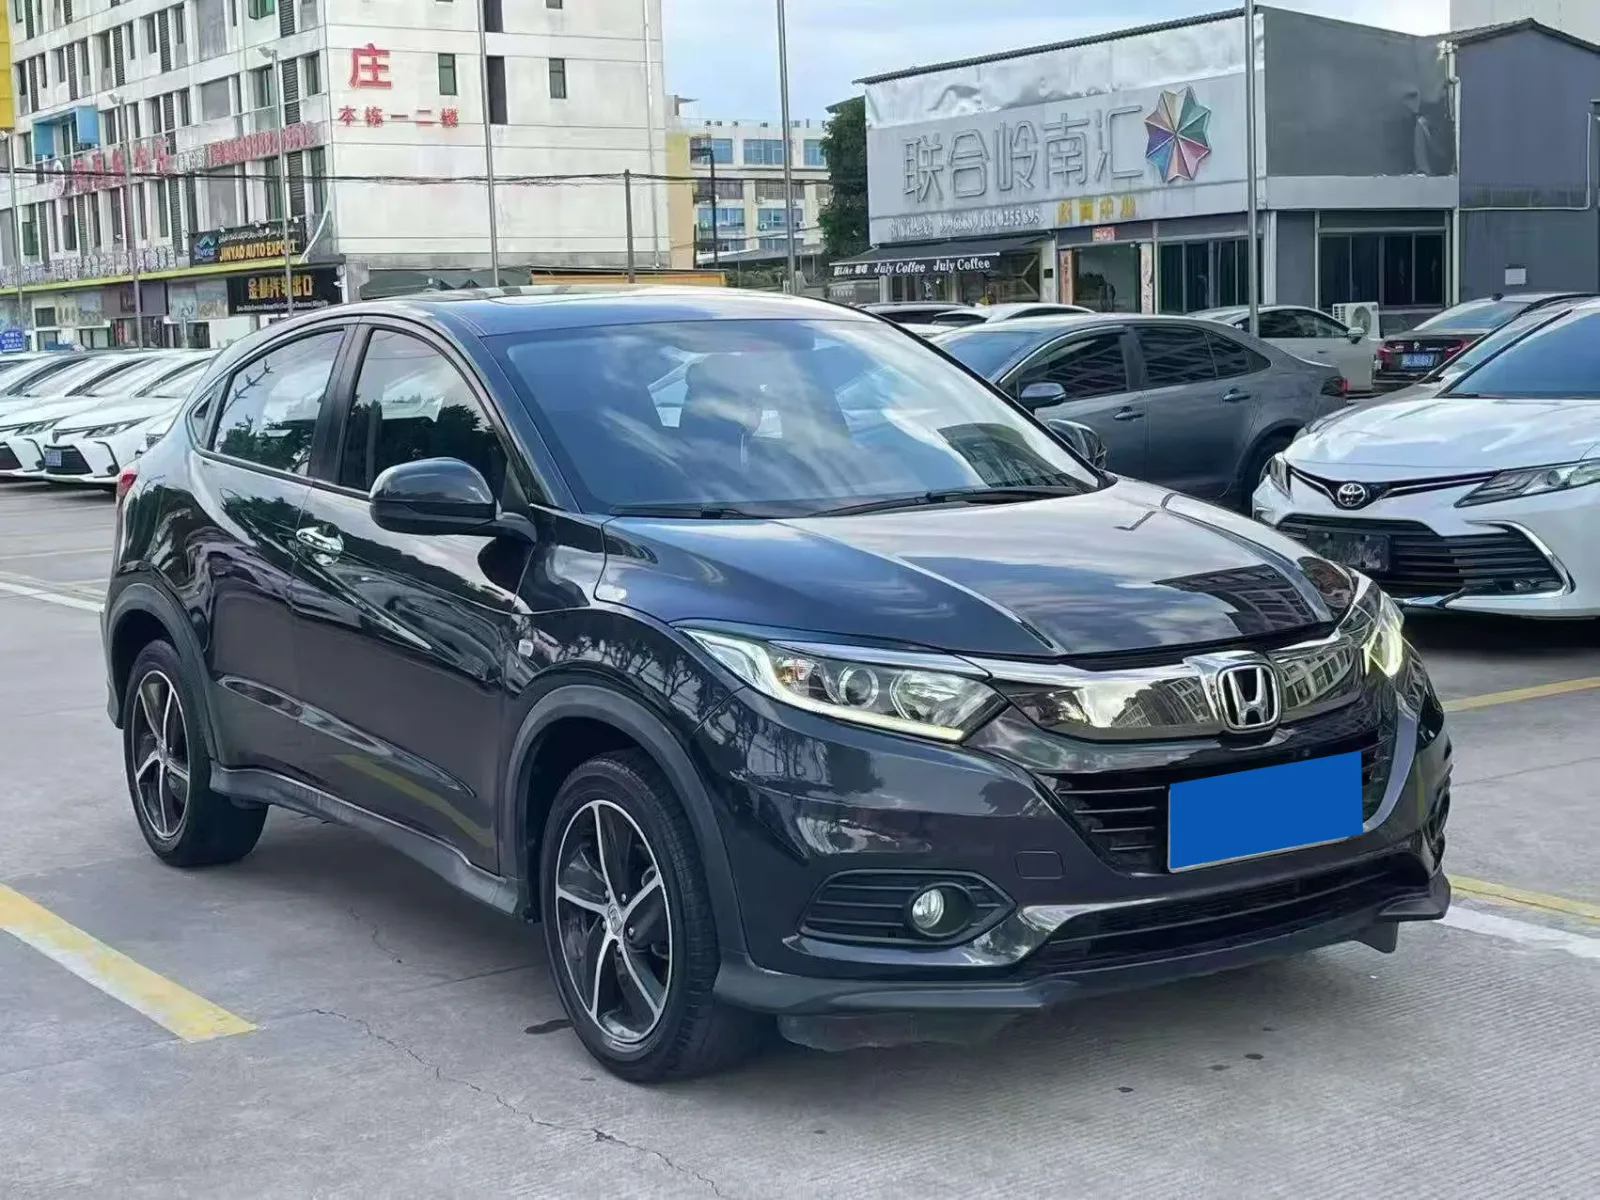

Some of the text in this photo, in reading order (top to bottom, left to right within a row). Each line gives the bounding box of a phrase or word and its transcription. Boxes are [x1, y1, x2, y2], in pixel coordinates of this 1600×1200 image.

[348, 43, 392, 89] 庄
[902, 104, 1144, 204] 联合岭南汇
[219, 244, 245, 262] JINYAO
[246, 241, 265, 259] AUTO
[267, 239, 297, 256] EXPOT
[873, 262, 894, 275] July
[895, 261, 926, 274] Coffee
[933, 259, 955, 273] July
[957, 257, 991, 271] Coffee
